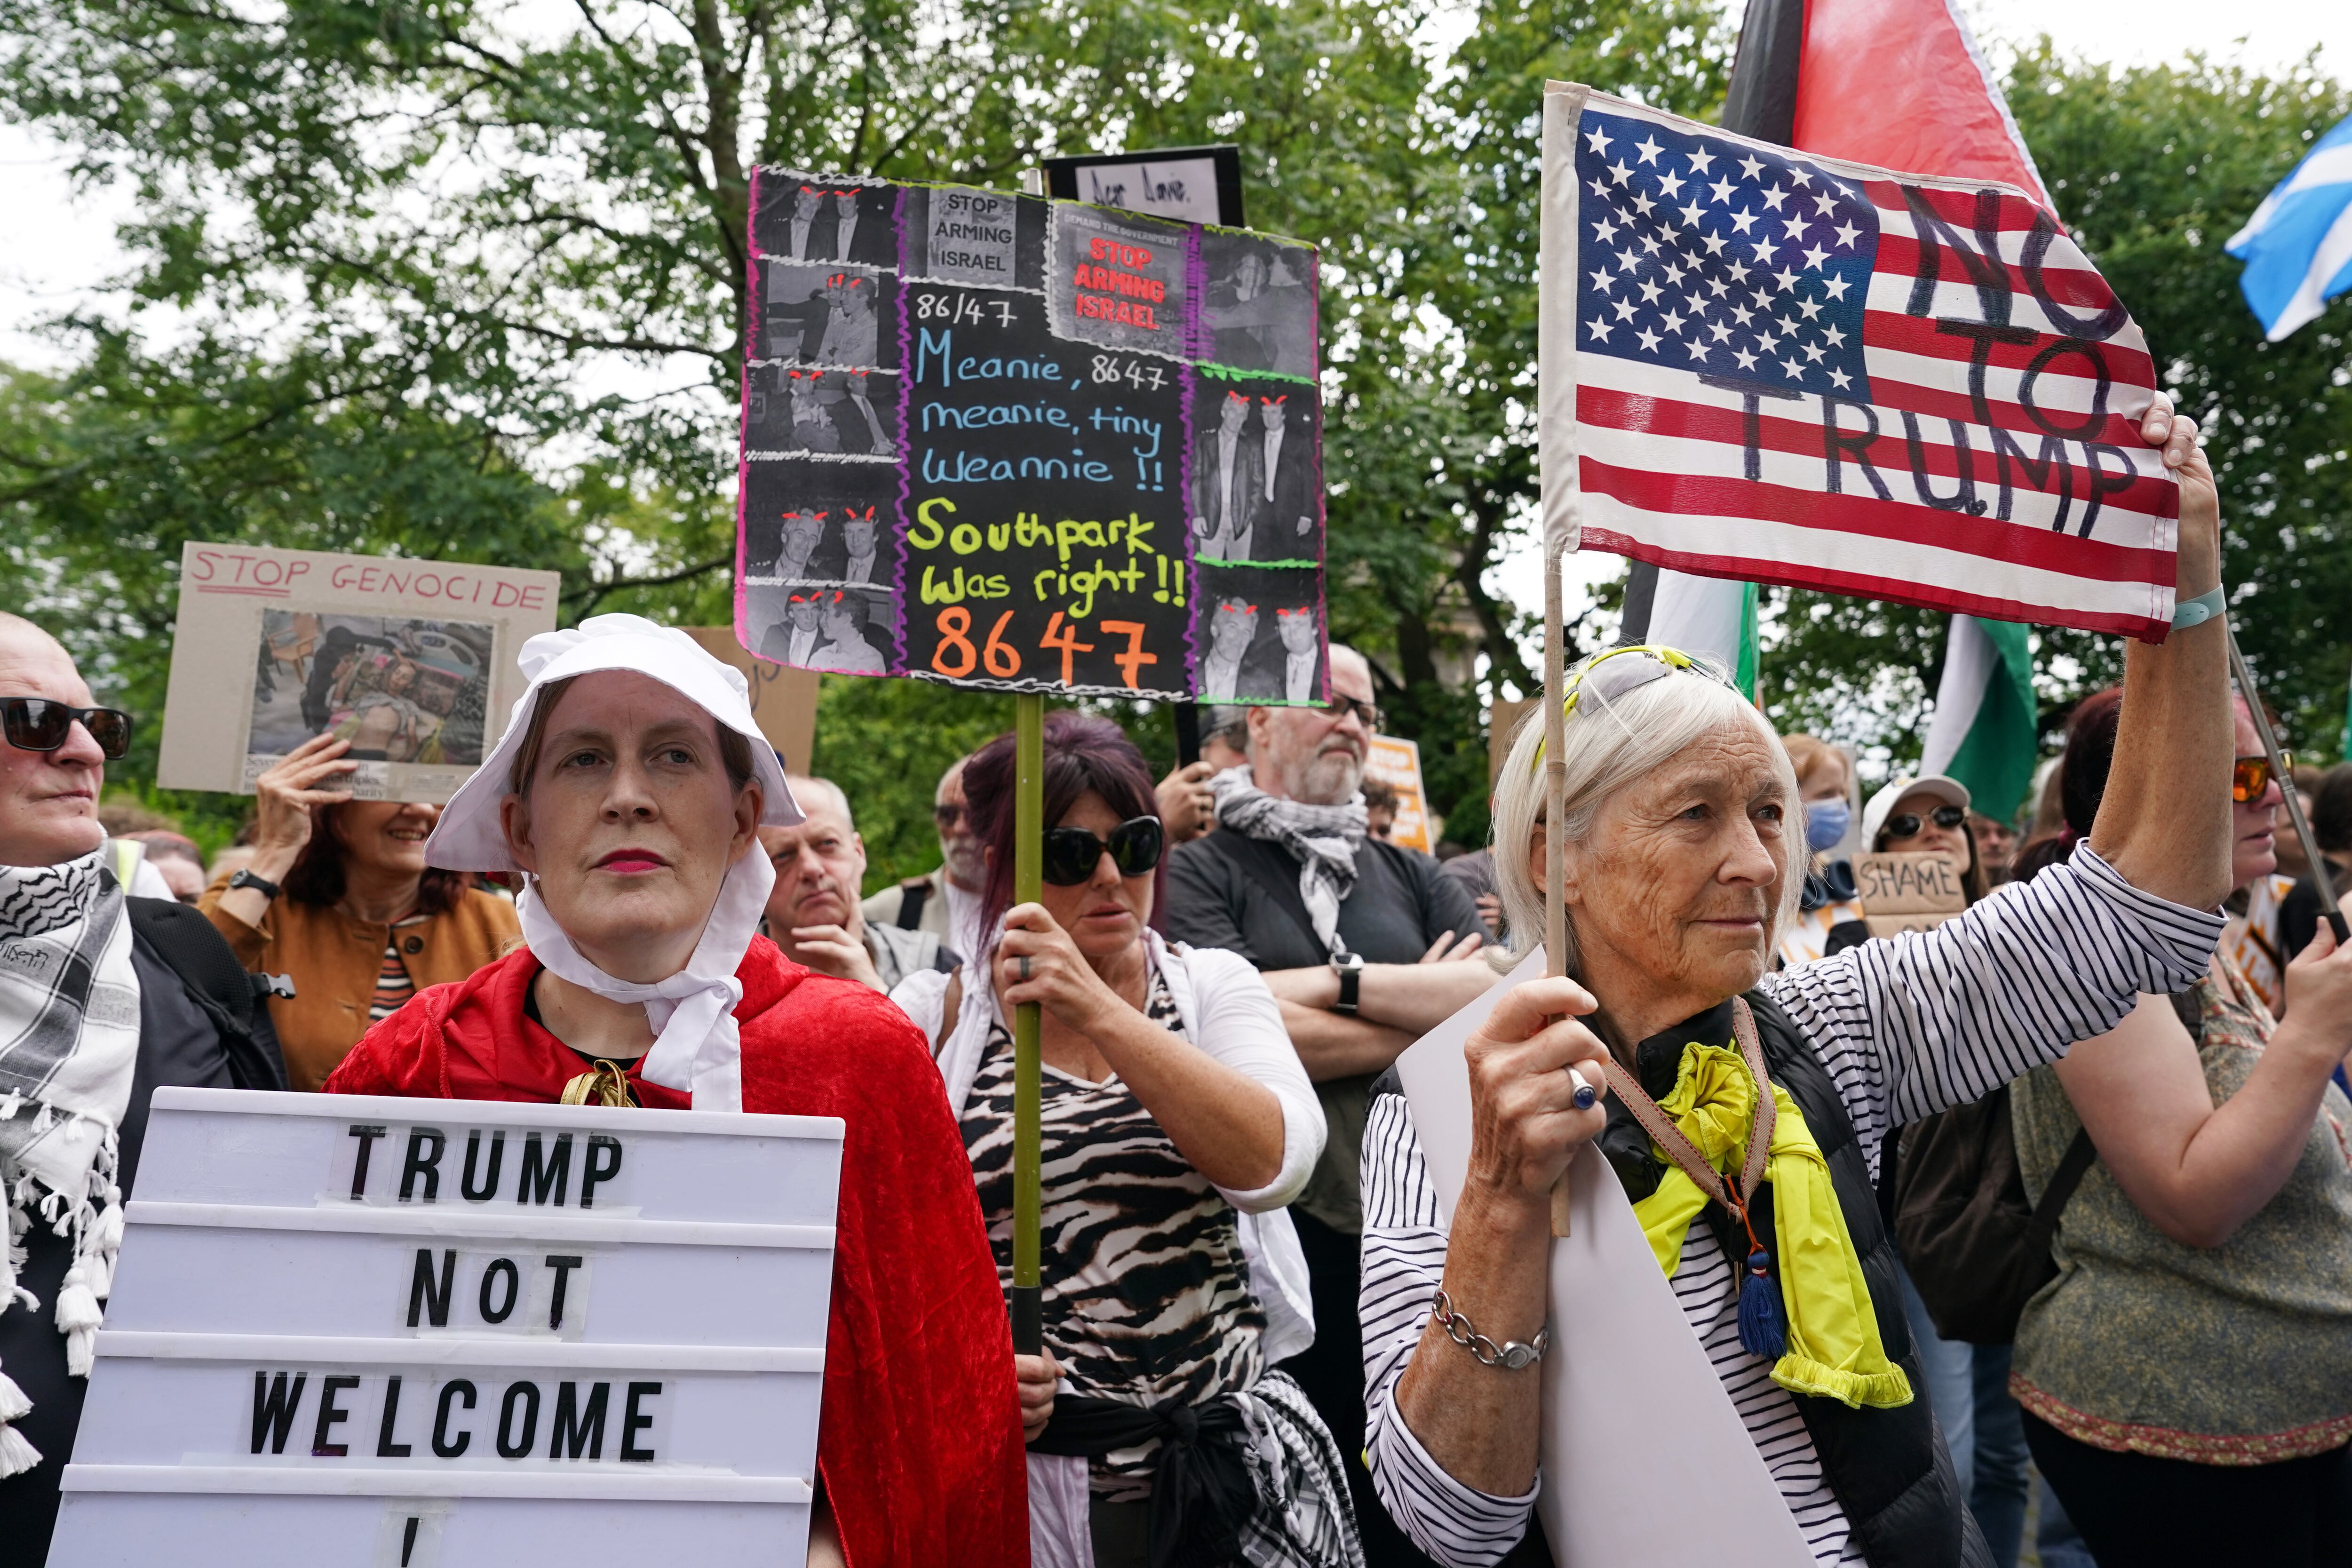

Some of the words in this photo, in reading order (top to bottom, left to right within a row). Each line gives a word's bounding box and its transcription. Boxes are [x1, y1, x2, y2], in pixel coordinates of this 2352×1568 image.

[948, 194, 998, 214] STOP
[1064, 214, 1102, 229] DEMAND
[1102, 222, 1120, 234] THE
[935, 222, 1012, 245] ARMING
[941, 251, 1006, 272] ISRAEL
[1089, 237, 1152, 271] STOP
[1073, 263, 1165, 303] ARMING
[1902, 185, 2128, 341] NO
[917, 293, 1017, 327] 86/47
[1075, 293, 1160, 331] ISRAEL
[916, 327, 1081, 390] Meanie,
[1936, 318, 2111, 441] TO
[922, 400, 1080, 435] meanie,
[1089, 406, 1162, 458] tiny
[1698, 373, 2137, 539] TRUMP
[906, 496, 1156, 563] Southpark
[191, 551, 310, 586] STOP
[332, 564, 547, 611] GENOCIDE
[1859, 859, 1958, 899] SHAME
[349, 1124, 623, 1210] TRUMP
[406, 1248, 582, 1331] NOT
[250, 1371, 663, 1463] WELCOME
